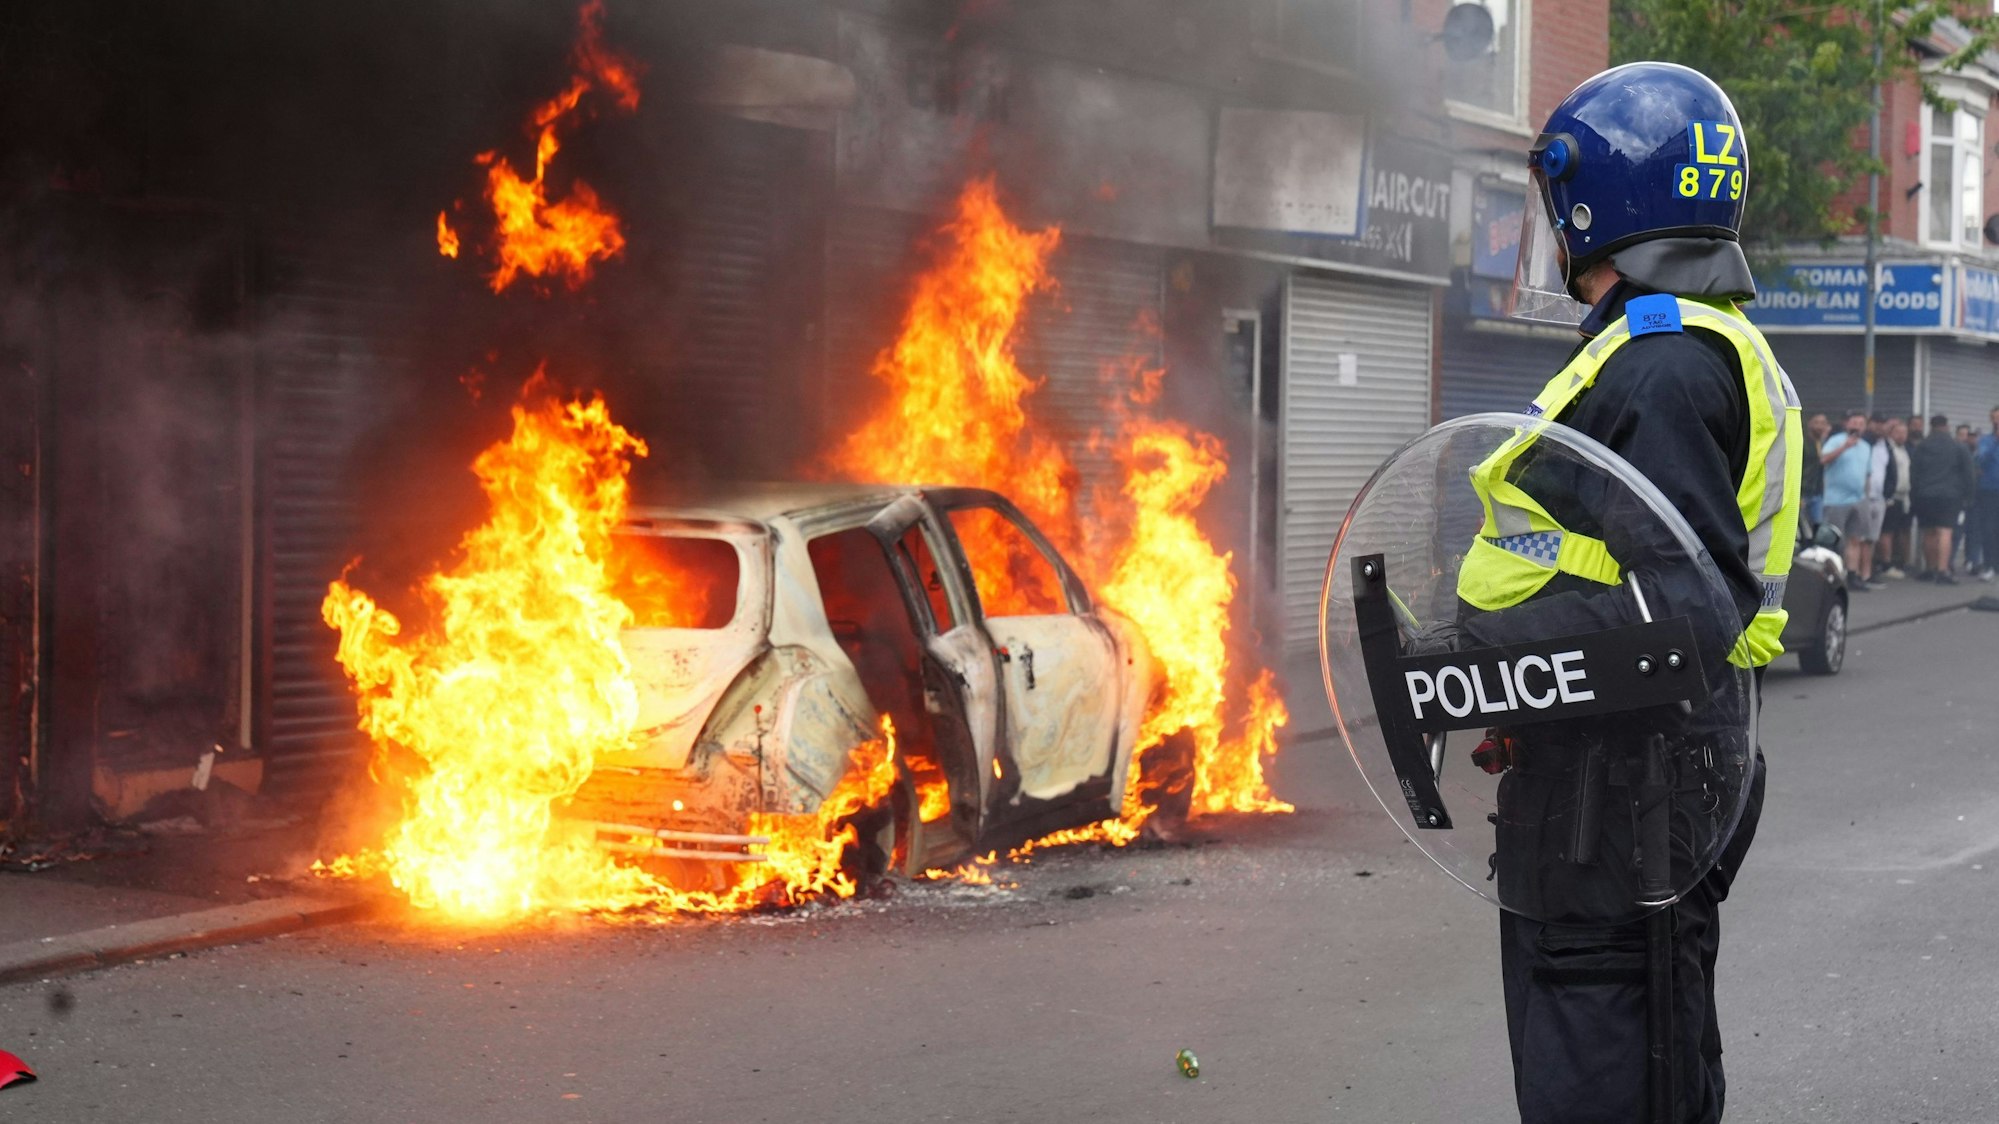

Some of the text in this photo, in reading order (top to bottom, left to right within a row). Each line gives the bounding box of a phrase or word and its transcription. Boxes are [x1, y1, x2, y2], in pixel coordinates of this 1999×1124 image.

[1693, 122, 1738, 166] LZ
[1678, 166, 1743, 200] 879
[1794, 267, 1895, 287] ROMANA
[1874, 290, 1940, 310] OODS
[1643, 313, 1666, 322] 879
[1404, 650, 1596, 720] POLICE
